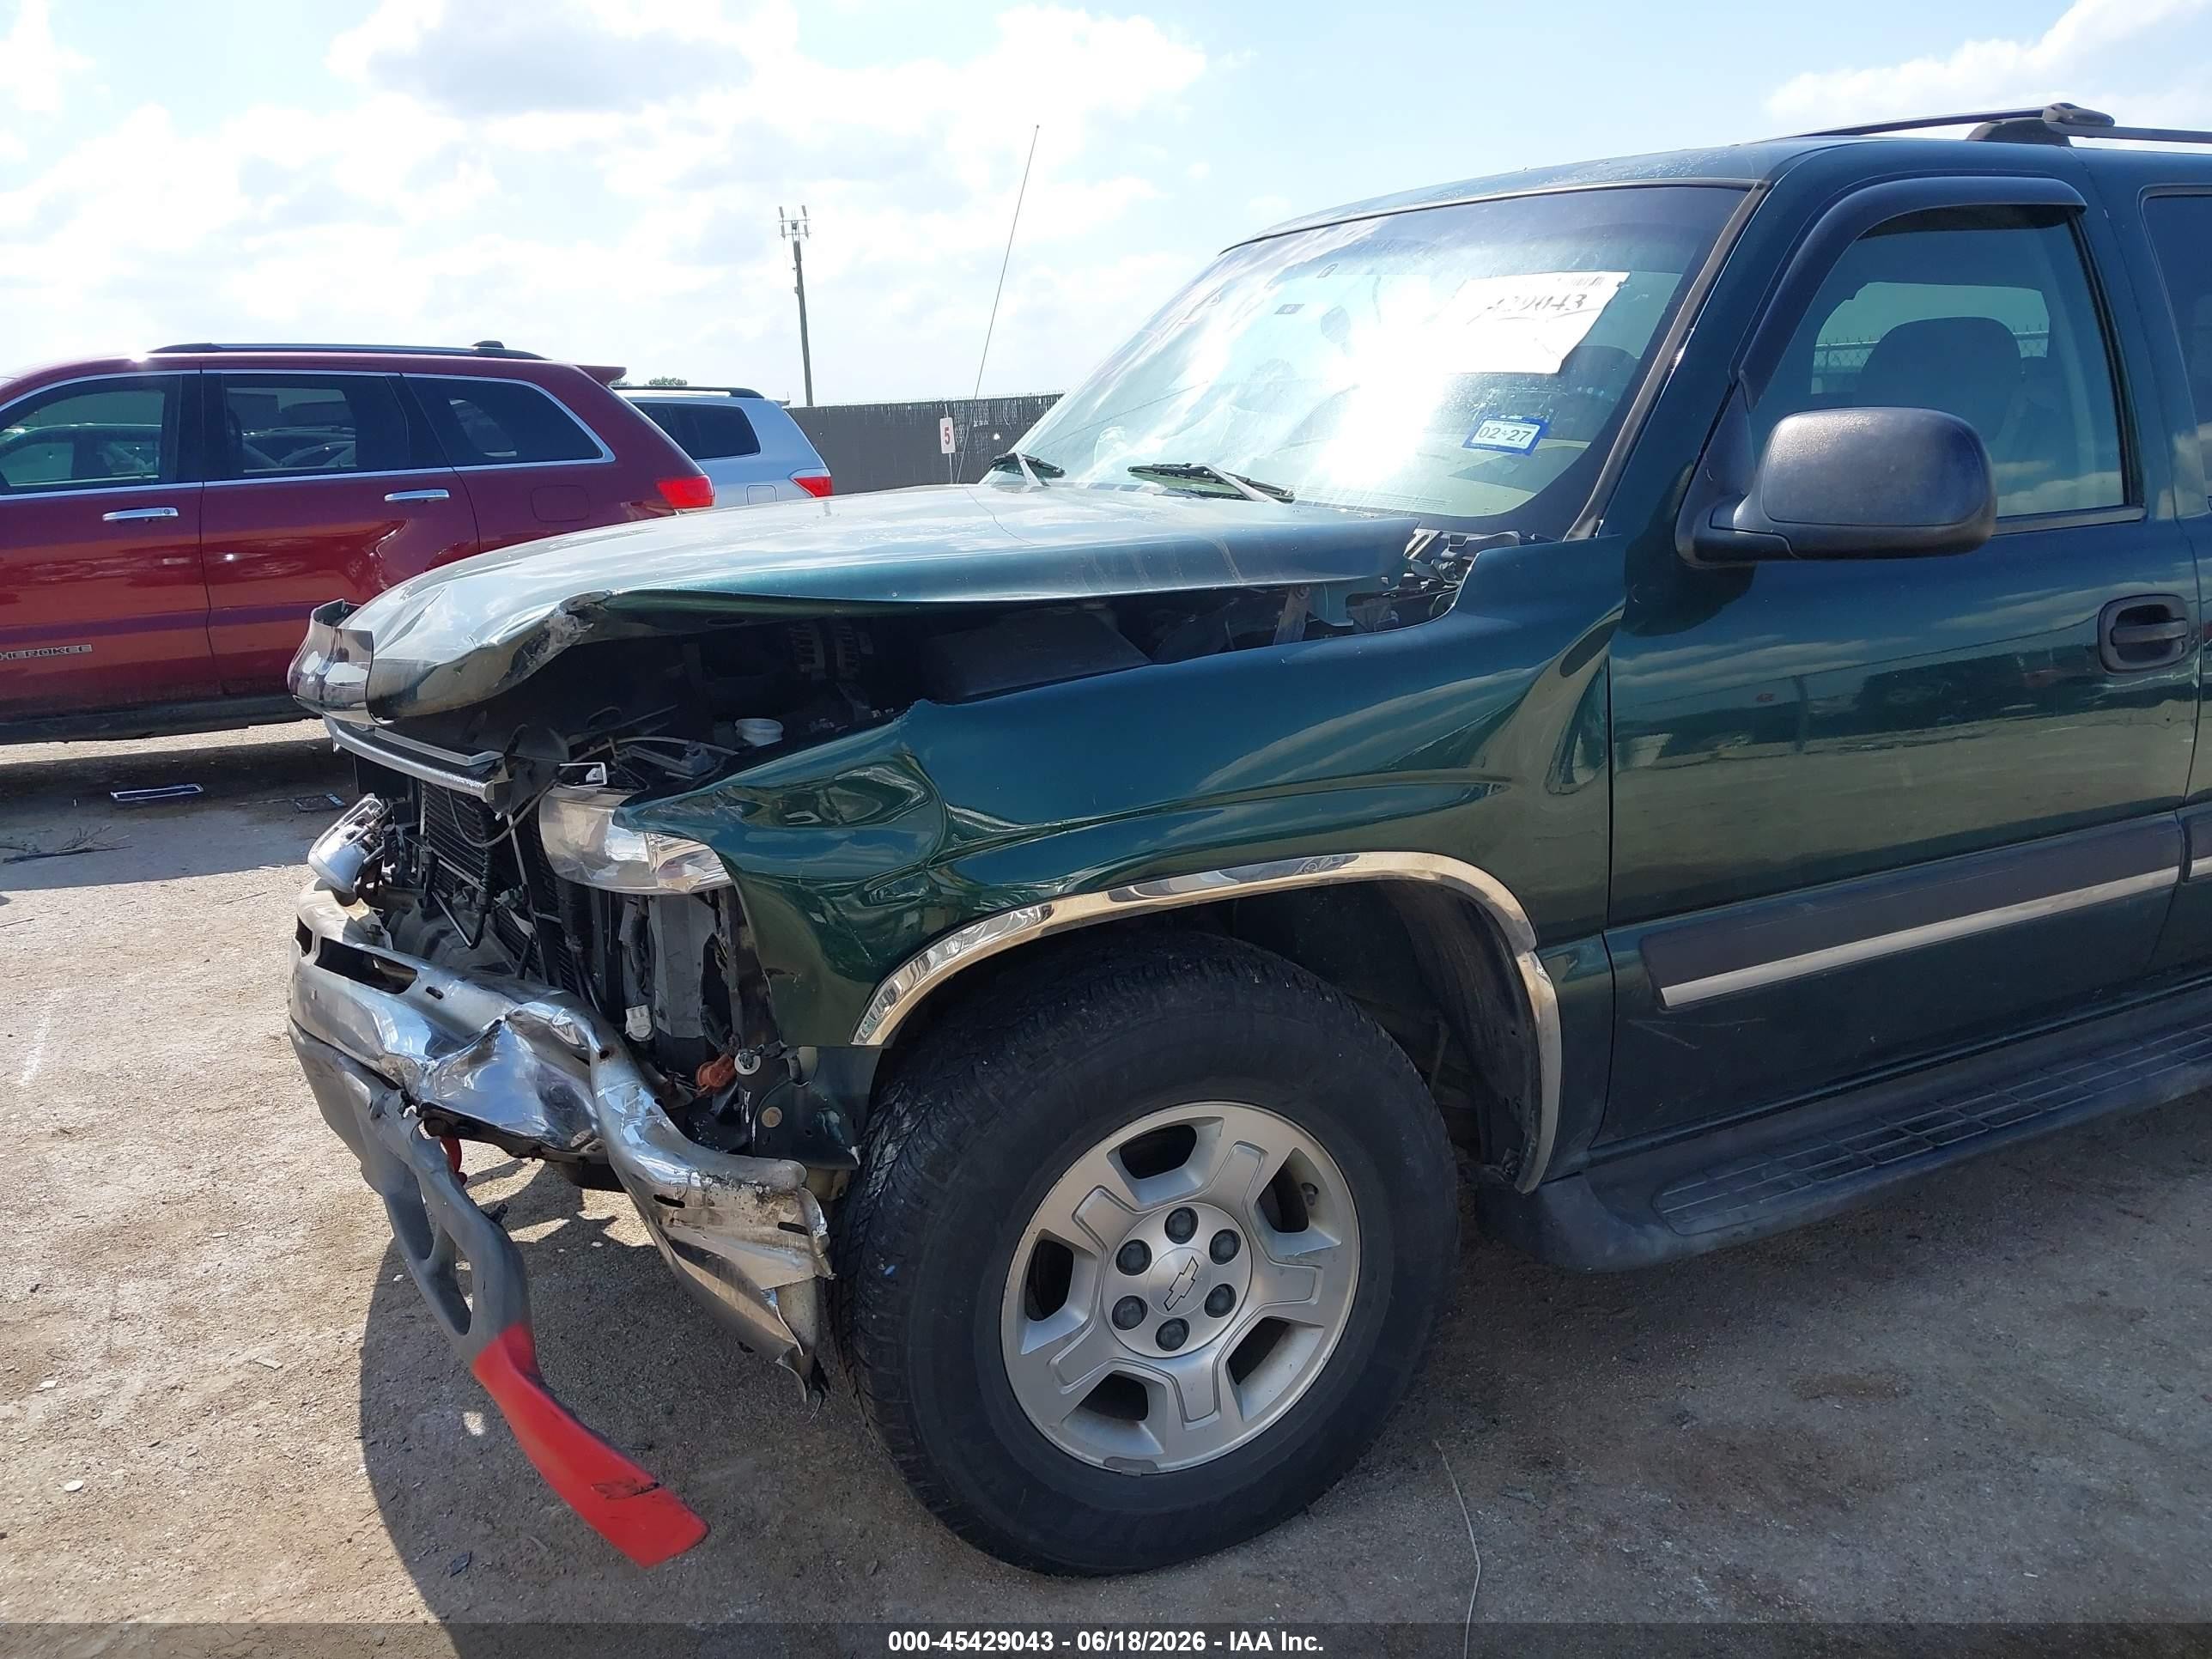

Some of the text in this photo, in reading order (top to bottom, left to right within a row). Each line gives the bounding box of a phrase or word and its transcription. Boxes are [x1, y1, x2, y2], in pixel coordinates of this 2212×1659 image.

[944, 426, 951, 446] 5
[1478, 426, 1532, 443] 02 27
